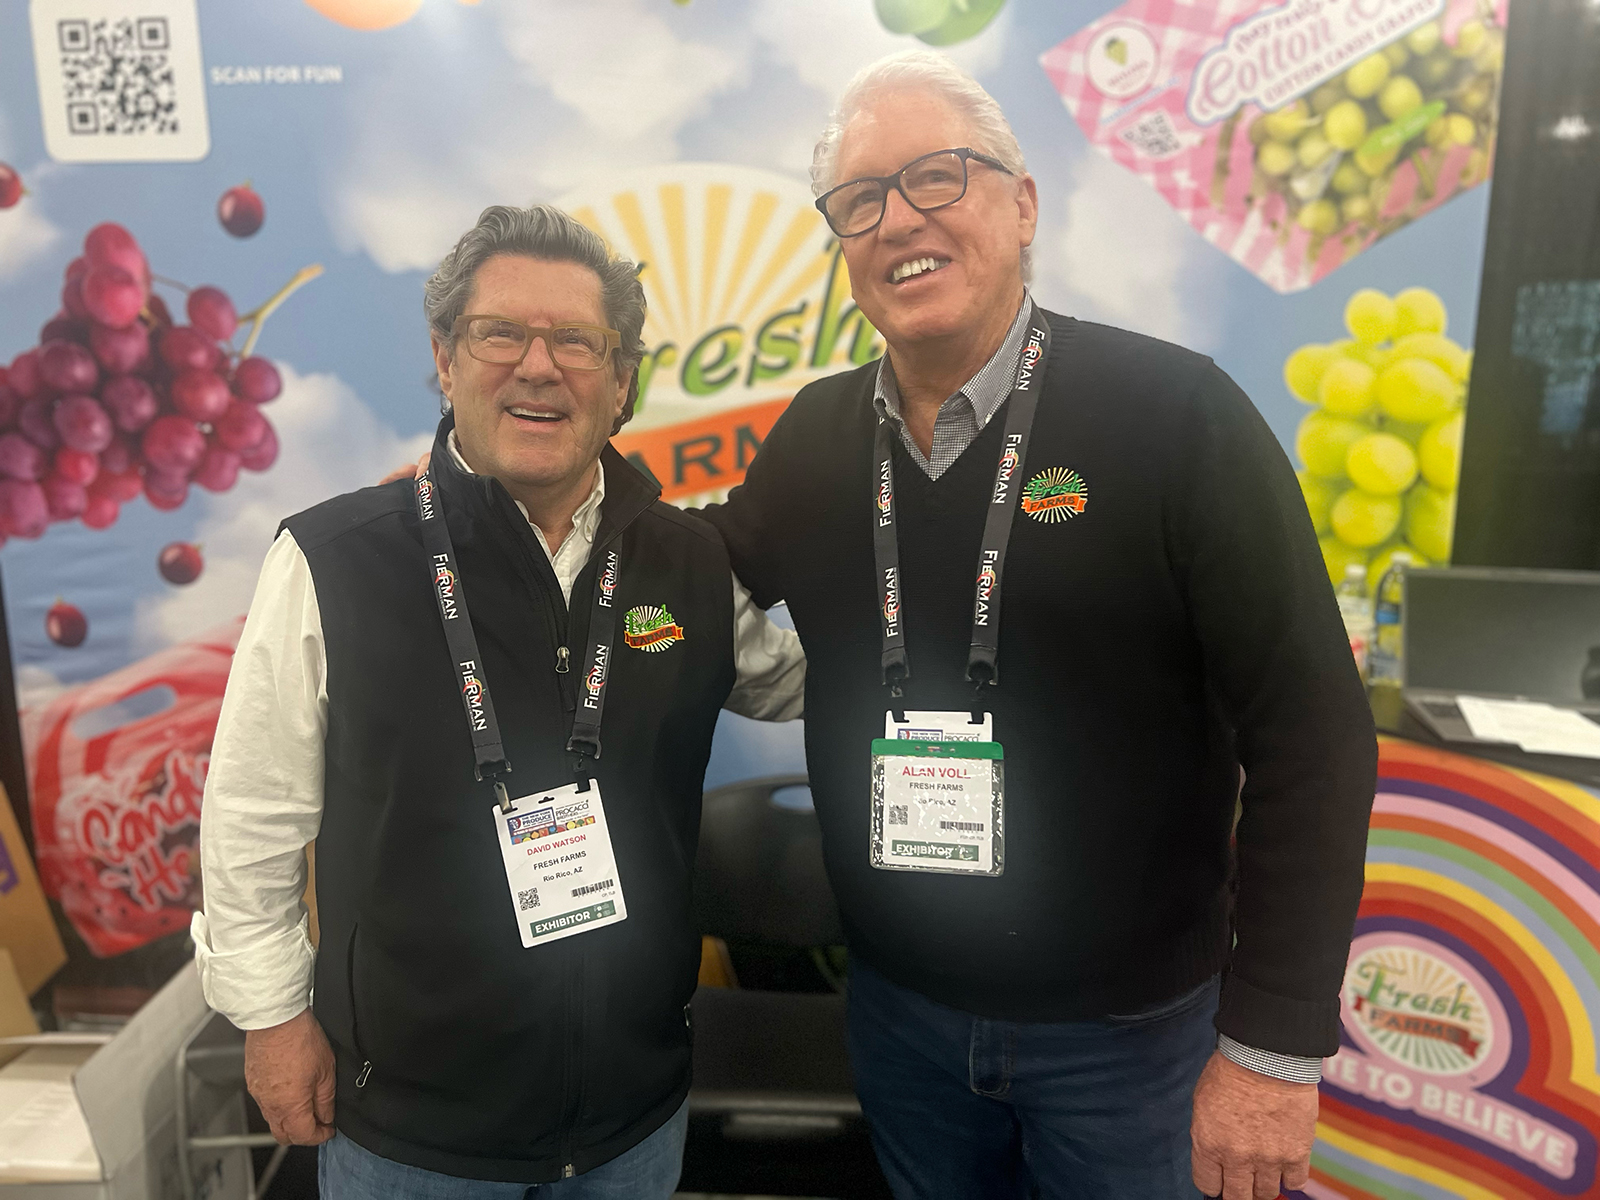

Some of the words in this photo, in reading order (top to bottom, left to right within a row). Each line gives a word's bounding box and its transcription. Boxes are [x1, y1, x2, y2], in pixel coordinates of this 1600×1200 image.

[210, 65, 261, 85] SCAN
[264, 65, 300, 84] FOR
[303, 65, 342, 84] FUN
[636, 238, 886, 413] resh
[1018, 326, 1045, 391] FIERMAN
[879, 459, 892, 528] FIERMAN
[994, 433, 1022, 505] FIERMAN
[1027, 474, 1081, 501] Fresh
[1030, 496, 1075, 511] FARMS
[433, 553, 458, 620] FIERMAN
[598, 550, 617, 608] FIERMAN
[885, 566, 898, 638] FIERMAN
[977, 550, 999, 626] FIERMAN
[459, 659, 488, 732] FIERMAN
[584, 643, 607, 710] FIERMAN
[902, 766, 935, 778] ALAN
[938, 767, 971, 780] VOLL
[909, 782, 935, 791] FRESH
[936, 783, 964, 792] FARMS
[83, 757, 209, 863] Cand
[522, 814, 552, 826] PRODUCE
[526, 843, 551, 857] DAVID
[552, 833, 587, 850] WATSON
[533, 856, 560, 871] FRESH
[560, 850, 587, 864] FARMS
[543, 872, 555, 883] Rio
[555, 869, 573, 880] Rico,
[573, 865, 584, 874] AZ
[896, 844, 953, 857] EXHIBITOR
[534, 910, 591, 934] EXHIBITOR
[1356, 960, 1473, 1023] Fresh
[1368, 1009, 1464, 1046] FARMS
[1365, 1064, 1414, 1100] TO
[1421, 1082, 1569, 1169] BELIEVE
